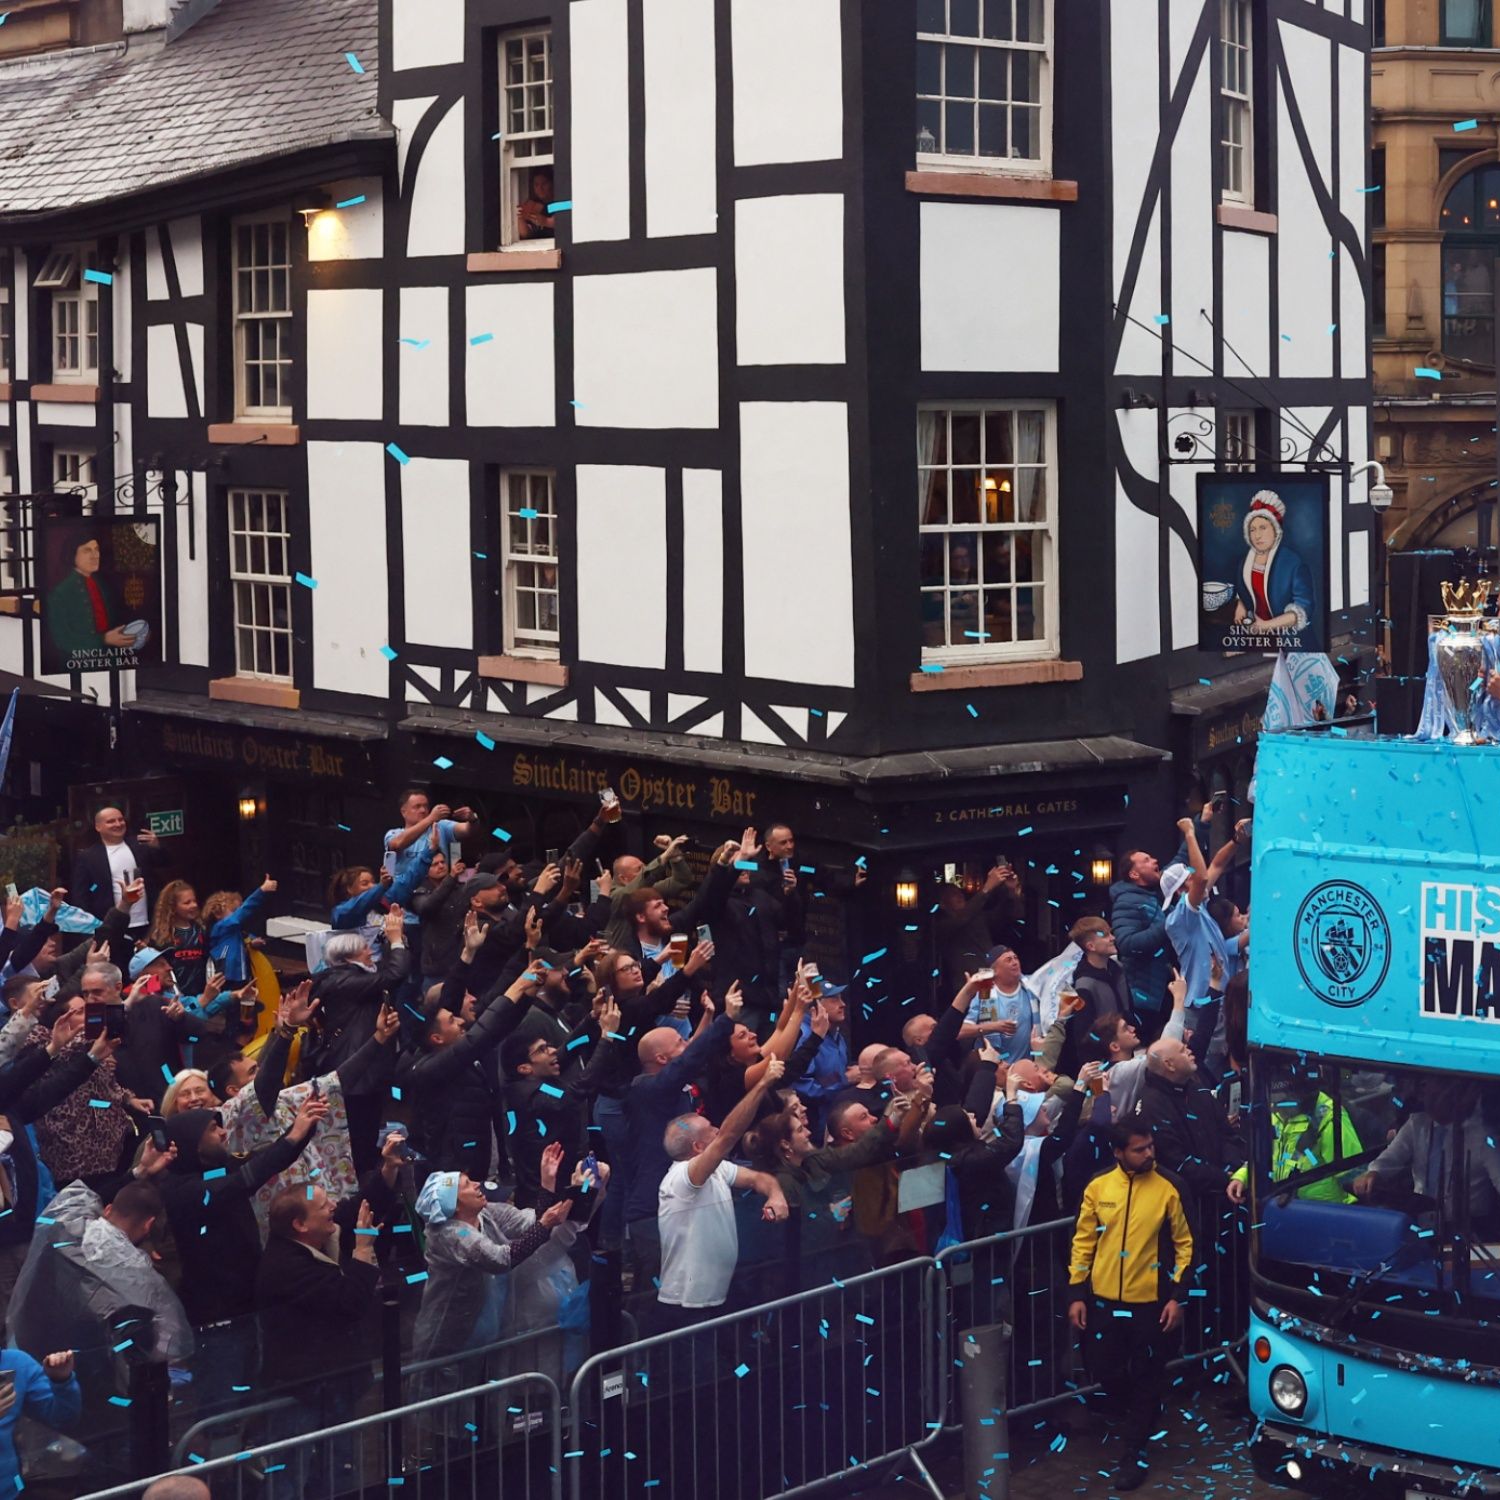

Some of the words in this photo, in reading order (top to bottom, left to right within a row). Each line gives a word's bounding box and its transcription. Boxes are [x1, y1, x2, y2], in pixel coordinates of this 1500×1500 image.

[1222, 636, 1272, 647] OYSTER
[1276, 636, 1302, 647] BAR
[66, 658, 112, 669] OYSTER
[115, 655, 140, 666] BAR
[307, 743, 344, 777] Bar
[512, 753, 608, 790] Sinclairs
[619, 767, 696, 811] Oyster
[709, 775, 756, 818] Bar
[935, 812, 942, 823] 2
[949, 803, 1031, 822] CATHEDRAL
[1037, 800, 1077, 814] GATES
[151, 814, 182, 833] Exit
[1303, 889, 1380, 931] MANCHESTER
[1328, 985, 1356, 998] CITY
